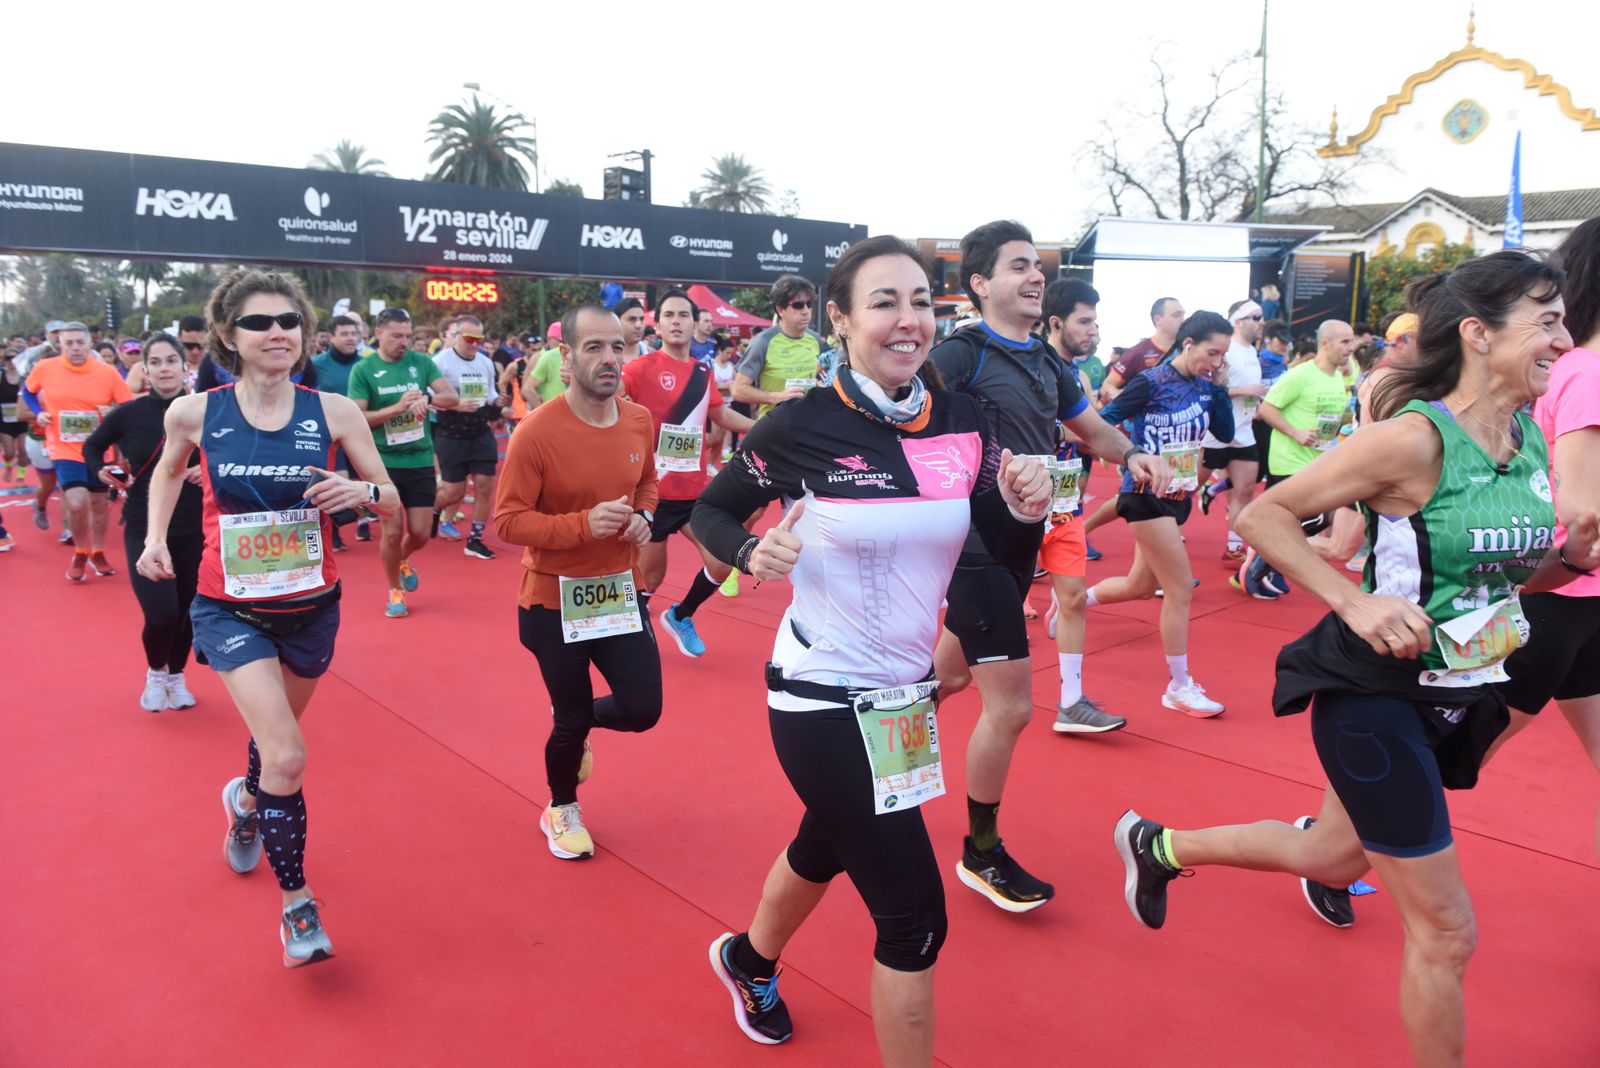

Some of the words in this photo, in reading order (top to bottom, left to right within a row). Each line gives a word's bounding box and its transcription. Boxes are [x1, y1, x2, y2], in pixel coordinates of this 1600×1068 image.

[0, 183, 84, 201] HYUNDAI
[135, 187, 235, 221] HOKA
[428, 208, 528, 232] maratón
[455, 228, 530, 250] sevilla
[580, 224, 645, 250] HOKA
[689, 238, 734, 250] HYUNDAI
[443, 250, 457, 261] 28
[458, 252, 488, 262] enero
[489, 253, 513, 264] 2024
[426, 280, 498, 302] 00:02:25
[668, 435, 695, 452] 7964
[218, 463, 312, 478] Vanessa
[828, 472, 894, 483] Running
[281, 510, 308, 524] SEVILLA
[237, 530, 300, 561] 8994
[572, 582, 619, 607] 6504
